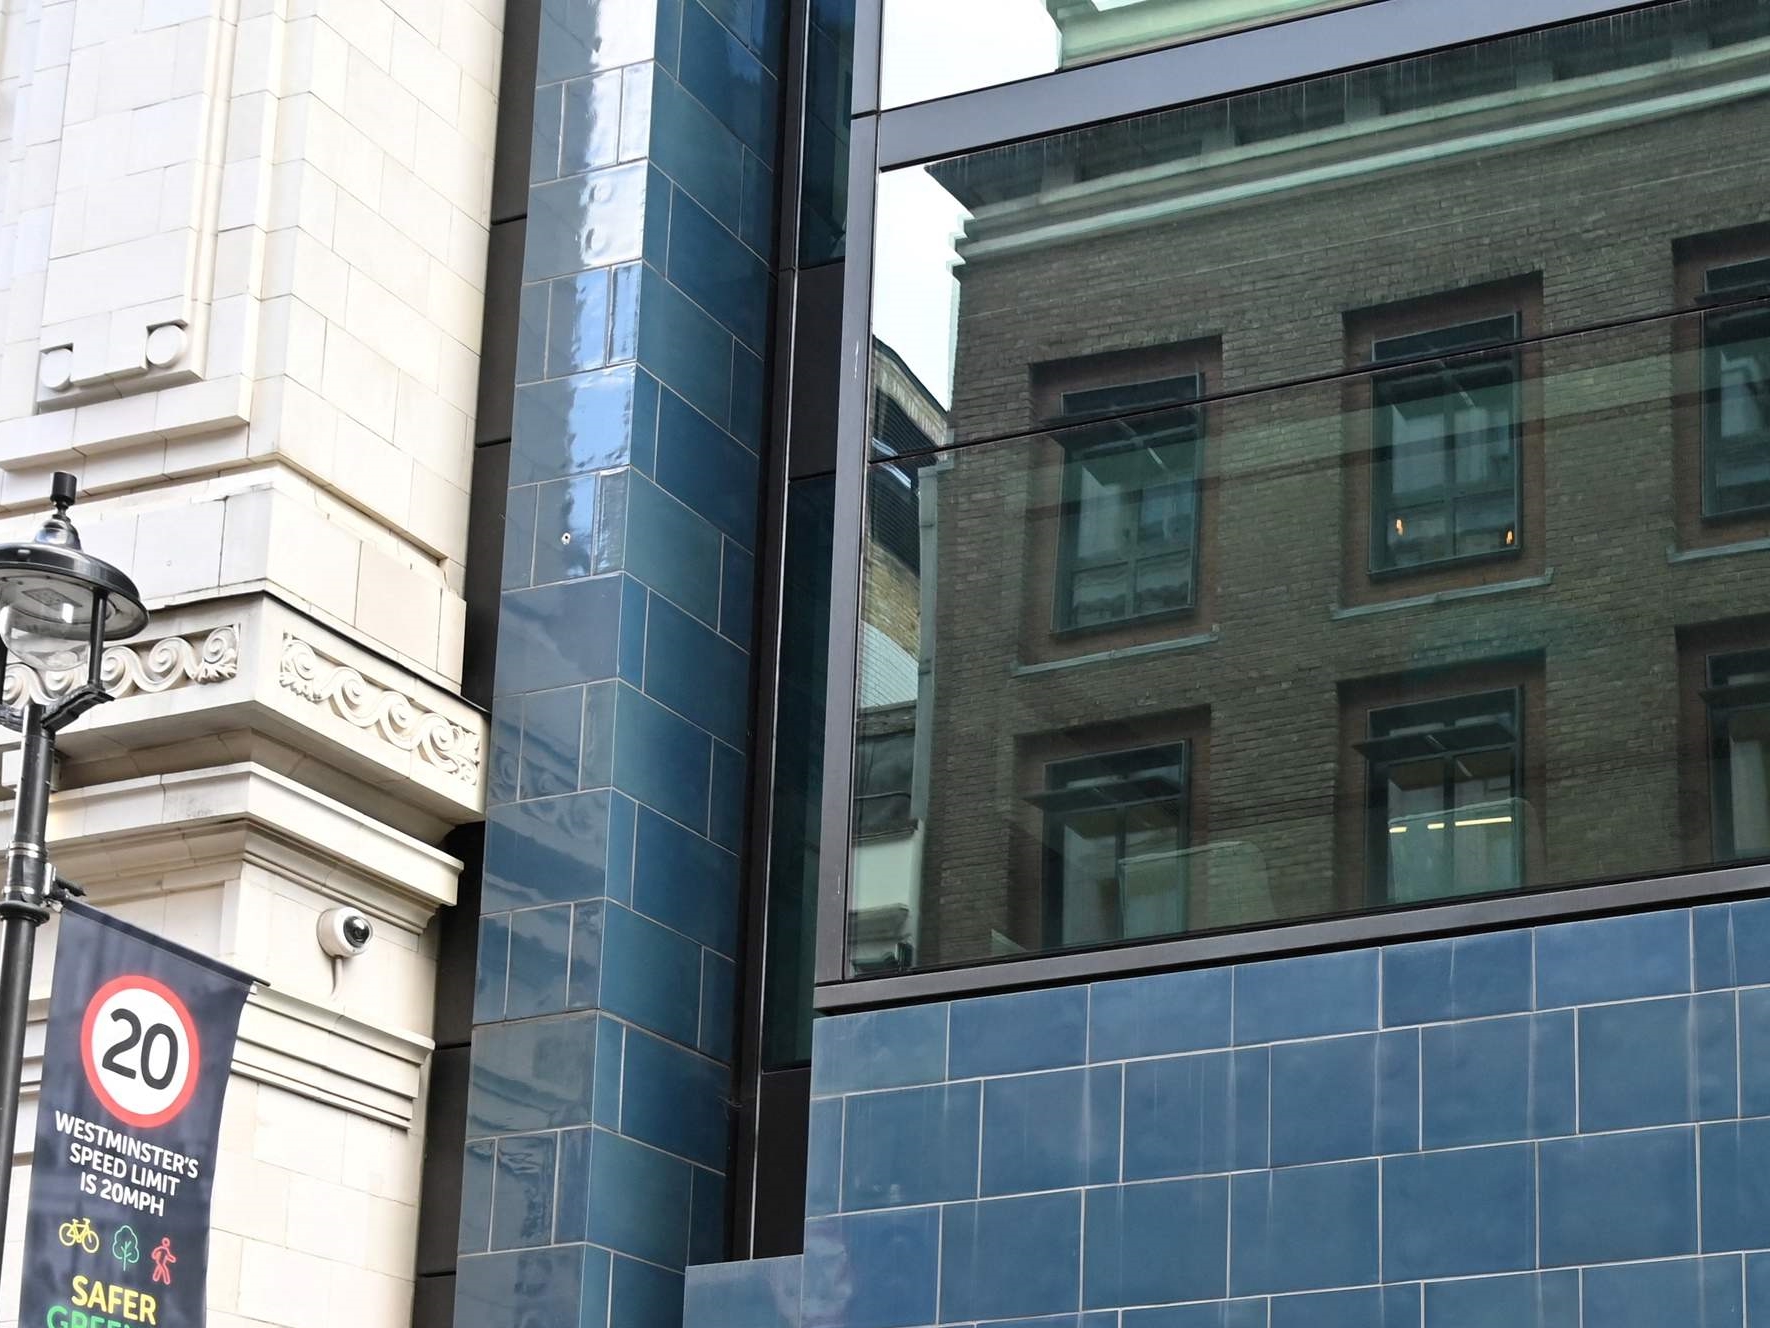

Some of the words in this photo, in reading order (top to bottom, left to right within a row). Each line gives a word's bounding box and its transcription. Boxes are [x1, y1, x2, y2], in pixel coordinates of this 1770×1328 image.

[101, 1008, 179, 1091] 20
[55, 1110, 199, 1179] WESTMINSTER'S
[69, 1142, 127, 1179] SPEED
[130, 1163, 181, 1196] LIMIT
[80, 1171, 98, 1195] IS
[100, 1178, 165, 1217] 20MPH
[71, 1275, 157, 1326] SAFER
